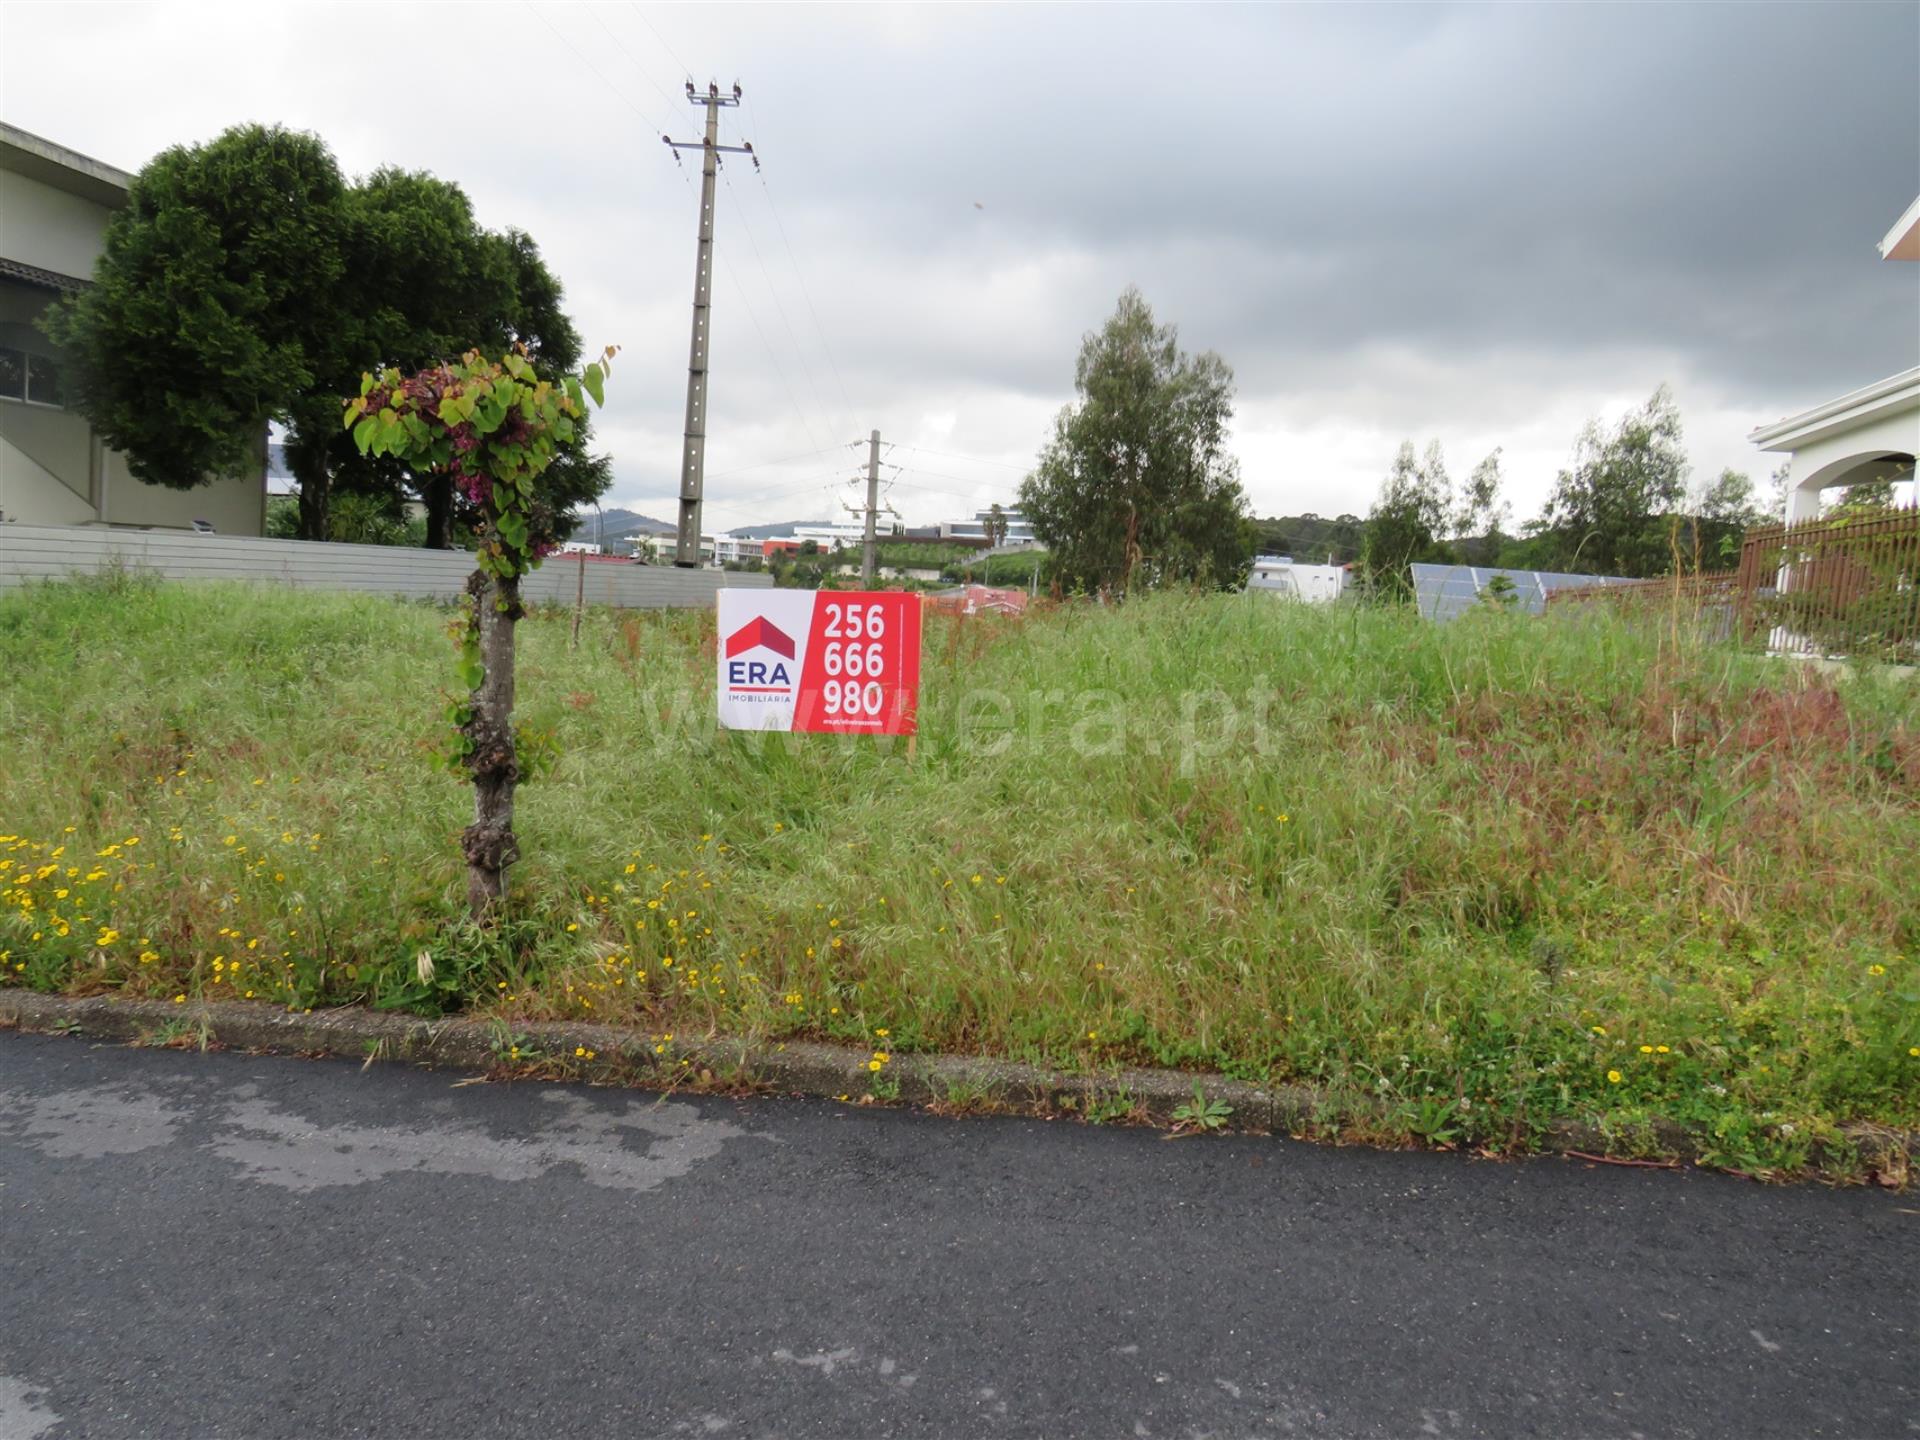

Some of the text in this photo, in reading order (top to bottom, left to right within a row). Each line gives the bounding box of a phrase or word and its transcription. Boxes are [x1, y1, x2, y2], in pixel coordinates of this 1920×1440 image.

[824, 603, 885, 639] 256
[729, 661, 791, 685] ERA
[824, 642, 884, 677] 666
[823, 680, 883, 716] 980
